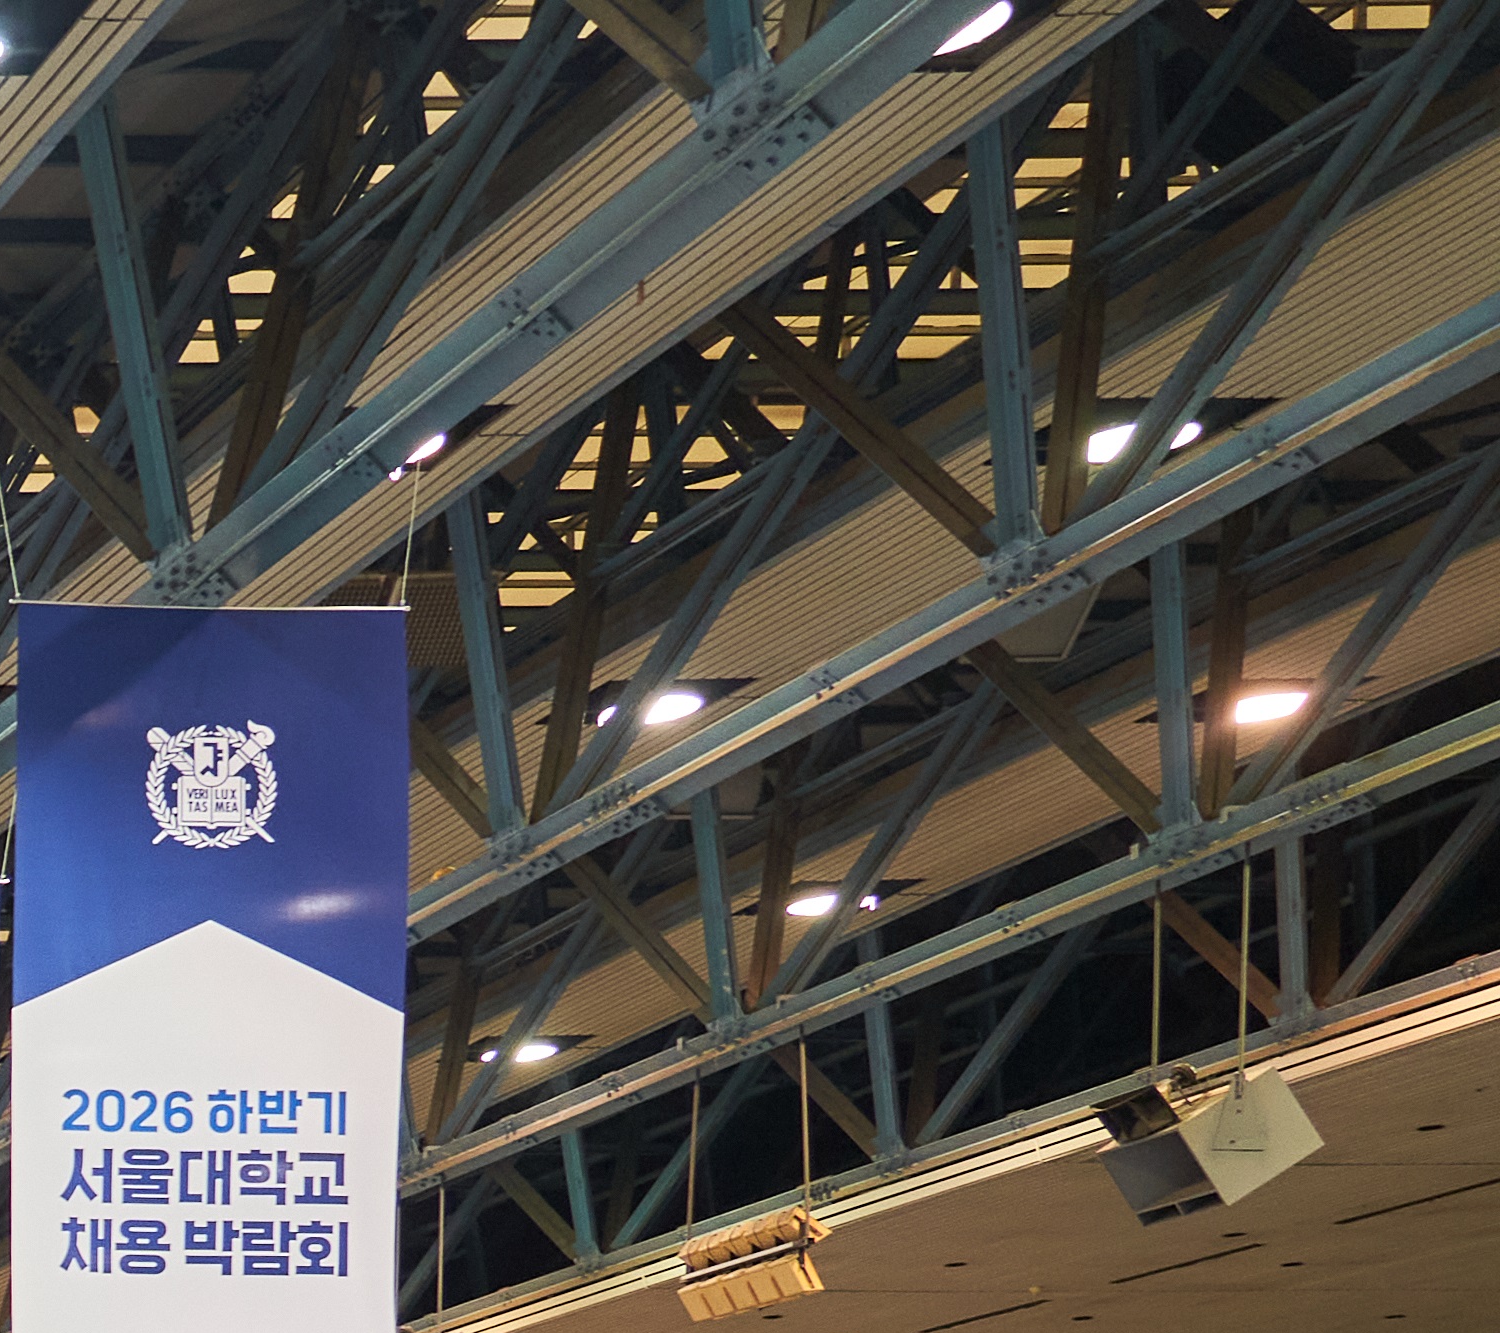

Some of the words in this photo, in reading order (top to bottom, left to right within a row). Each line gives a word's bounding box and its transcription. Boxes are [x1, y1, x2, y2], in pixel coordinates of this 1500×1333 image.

[62, 1089, 193, 1133] 2026
[208, 1090, 347, 1135] 하반기
[60, 1149, 348, 1205] 서울대학교
[59, 1217, 169, 1277] 채용
[185, 1221, 348, 1277] 박람회
